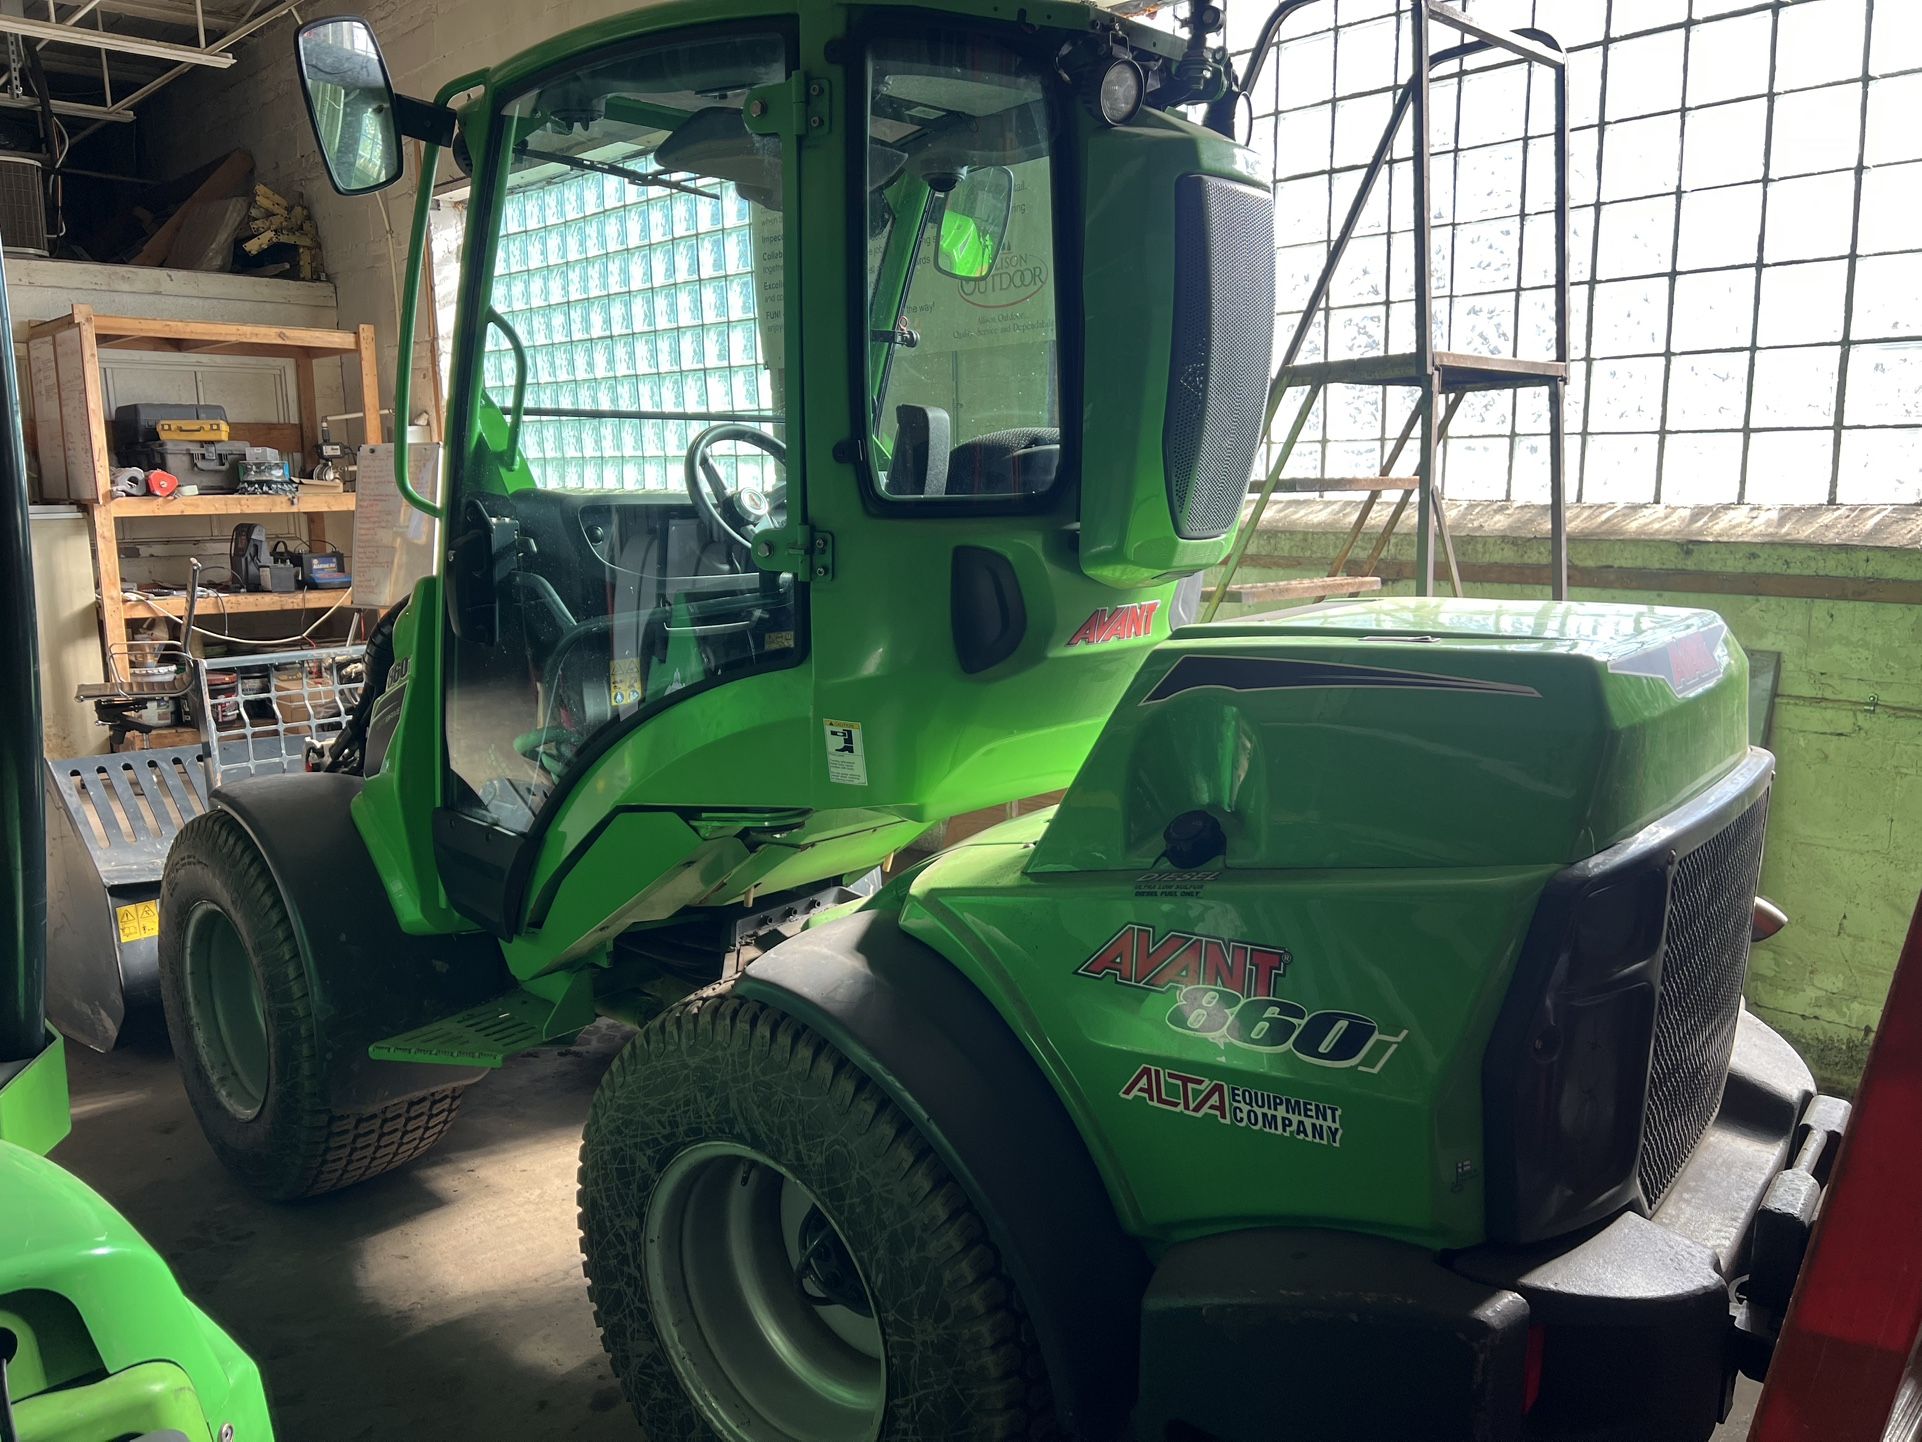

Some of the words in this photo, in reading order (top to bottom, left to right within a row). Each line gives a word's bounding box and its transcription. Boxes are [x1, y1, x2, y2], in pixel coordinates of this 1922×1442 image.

[960, 266, 1045, 296] OUTDOOR
[1065, 600, 1161, 647] AVANT
[1136, 871, 1220, 881] DIESEL
[1073, 922, 1287, 1000] AVANT
[1119, 1064, 1230, 1124] ALTA
[1230, 1086, 1342, 1125] EQUIPMENT
[1231, 1105, 1343, 1148] COMPANY
